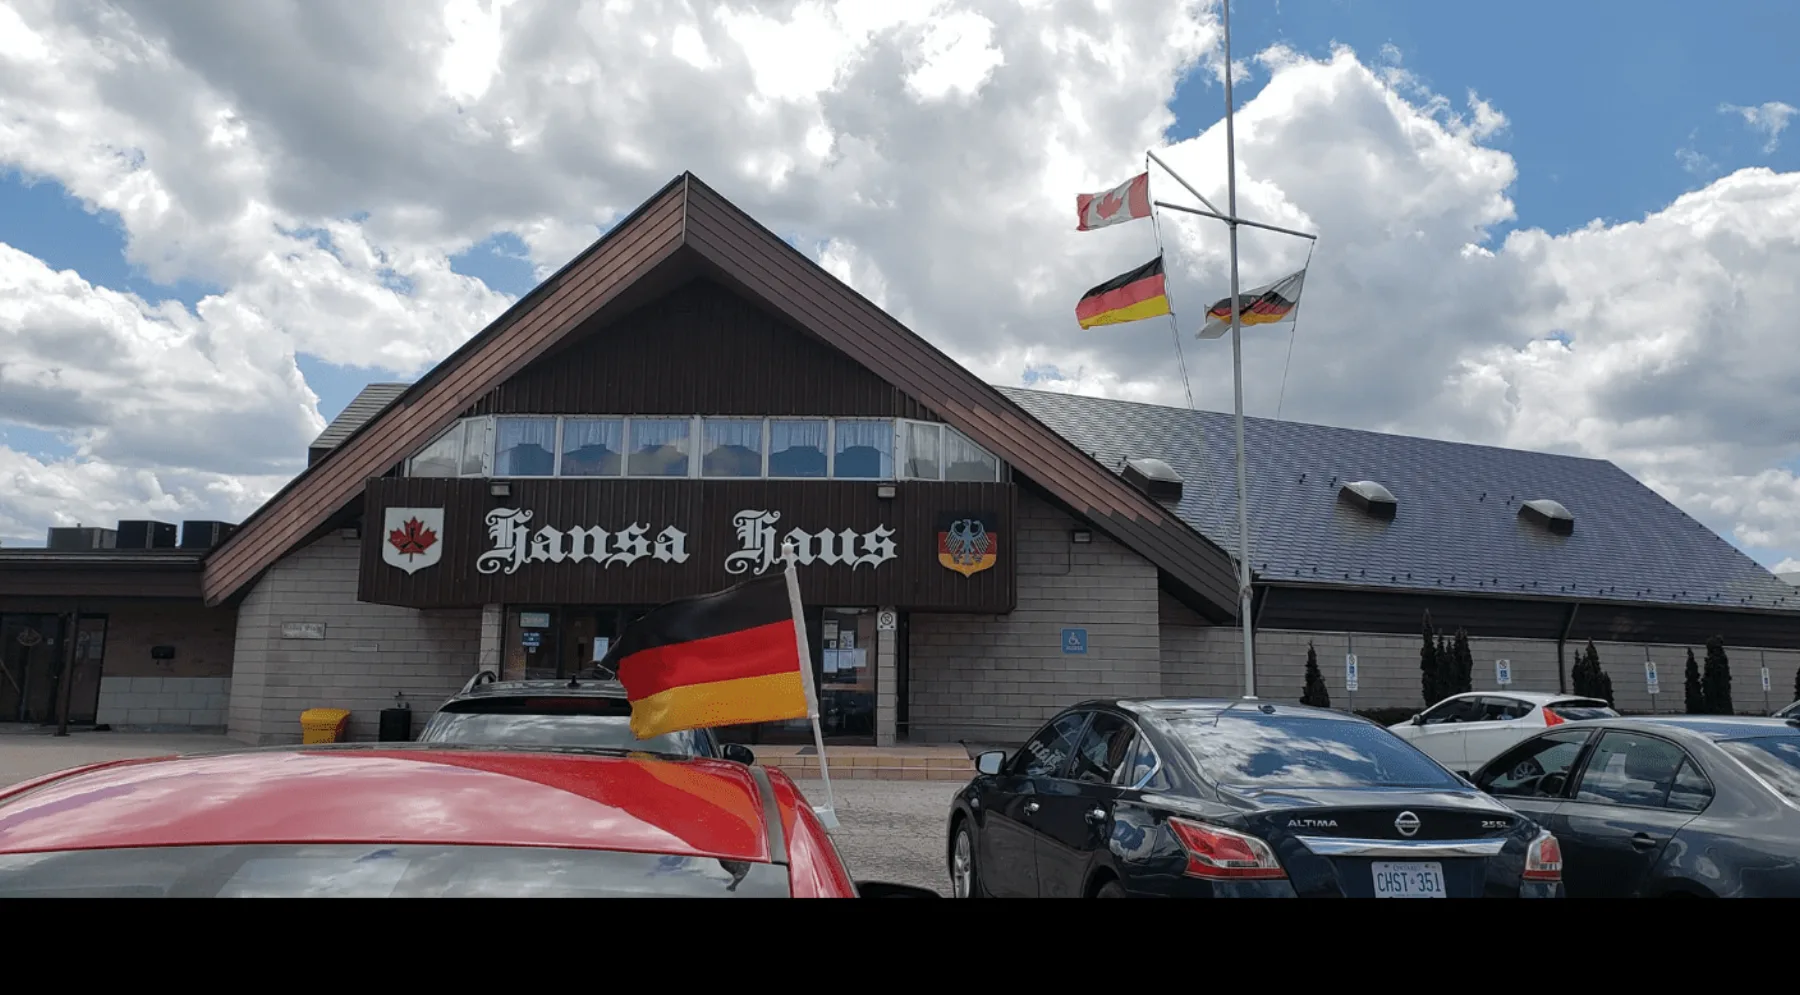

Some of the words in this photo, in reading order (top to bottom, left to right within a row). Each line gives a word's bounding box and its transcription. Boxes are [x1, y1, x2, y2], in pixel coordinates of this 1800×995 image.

[476, 507, 690, 575] Hansa
[724, 508, 898, 575] Haus
[1288, 819, 1338, 827] ALTIMA
[1377, 871, 1408, 892] CHST
[1416, 871, 1441, 892] 351
